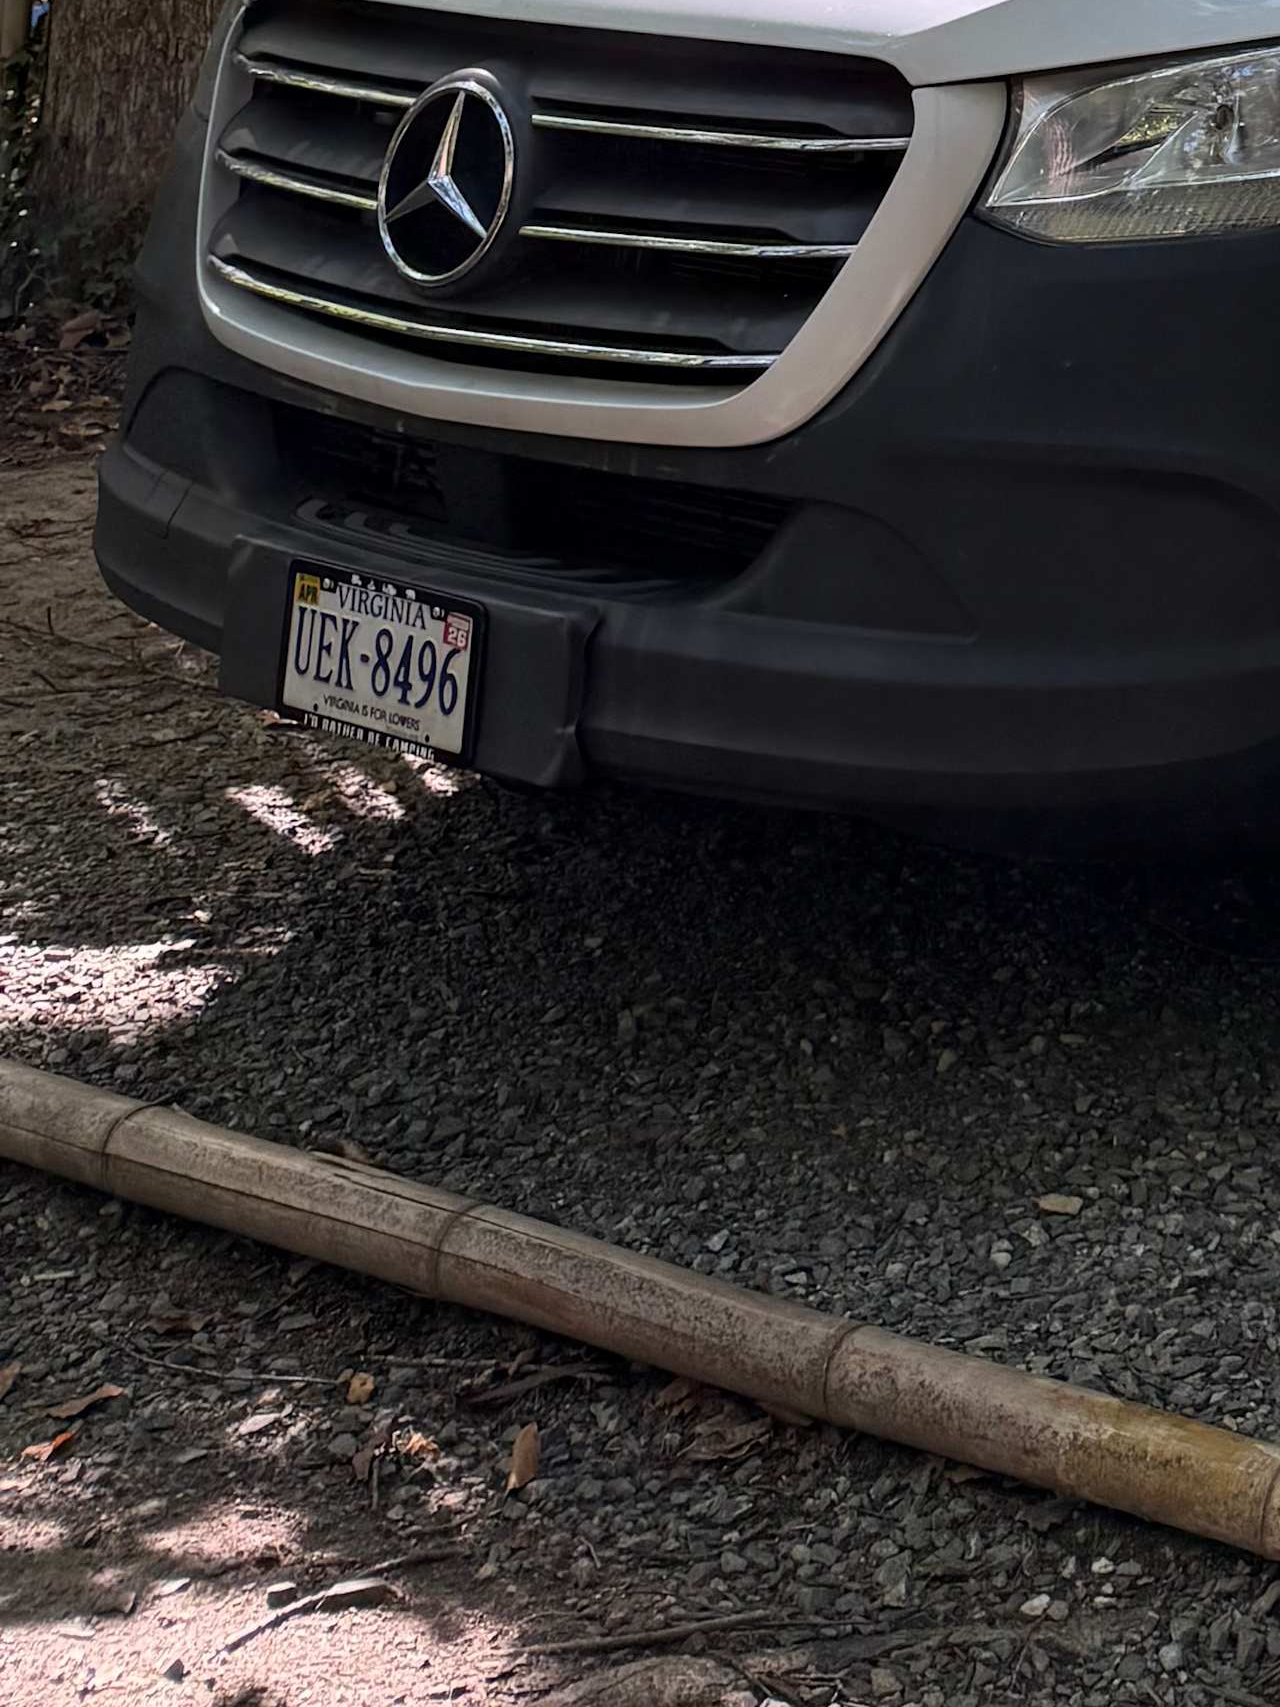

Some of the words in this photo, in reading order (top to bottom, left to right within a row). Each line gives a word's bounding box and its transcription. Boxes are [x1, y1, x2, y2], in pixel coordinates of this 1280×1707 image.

[336, 585, 427, 630] VIRGINIA
[294, 606, 462, 716] UEK-8496
[323, 694, 359, 714] VIRGINIA
[361, 705, 368, 717] IS
[370, 707, 387, 723] FOR
[388, 713, 420, 731] LOVERS
